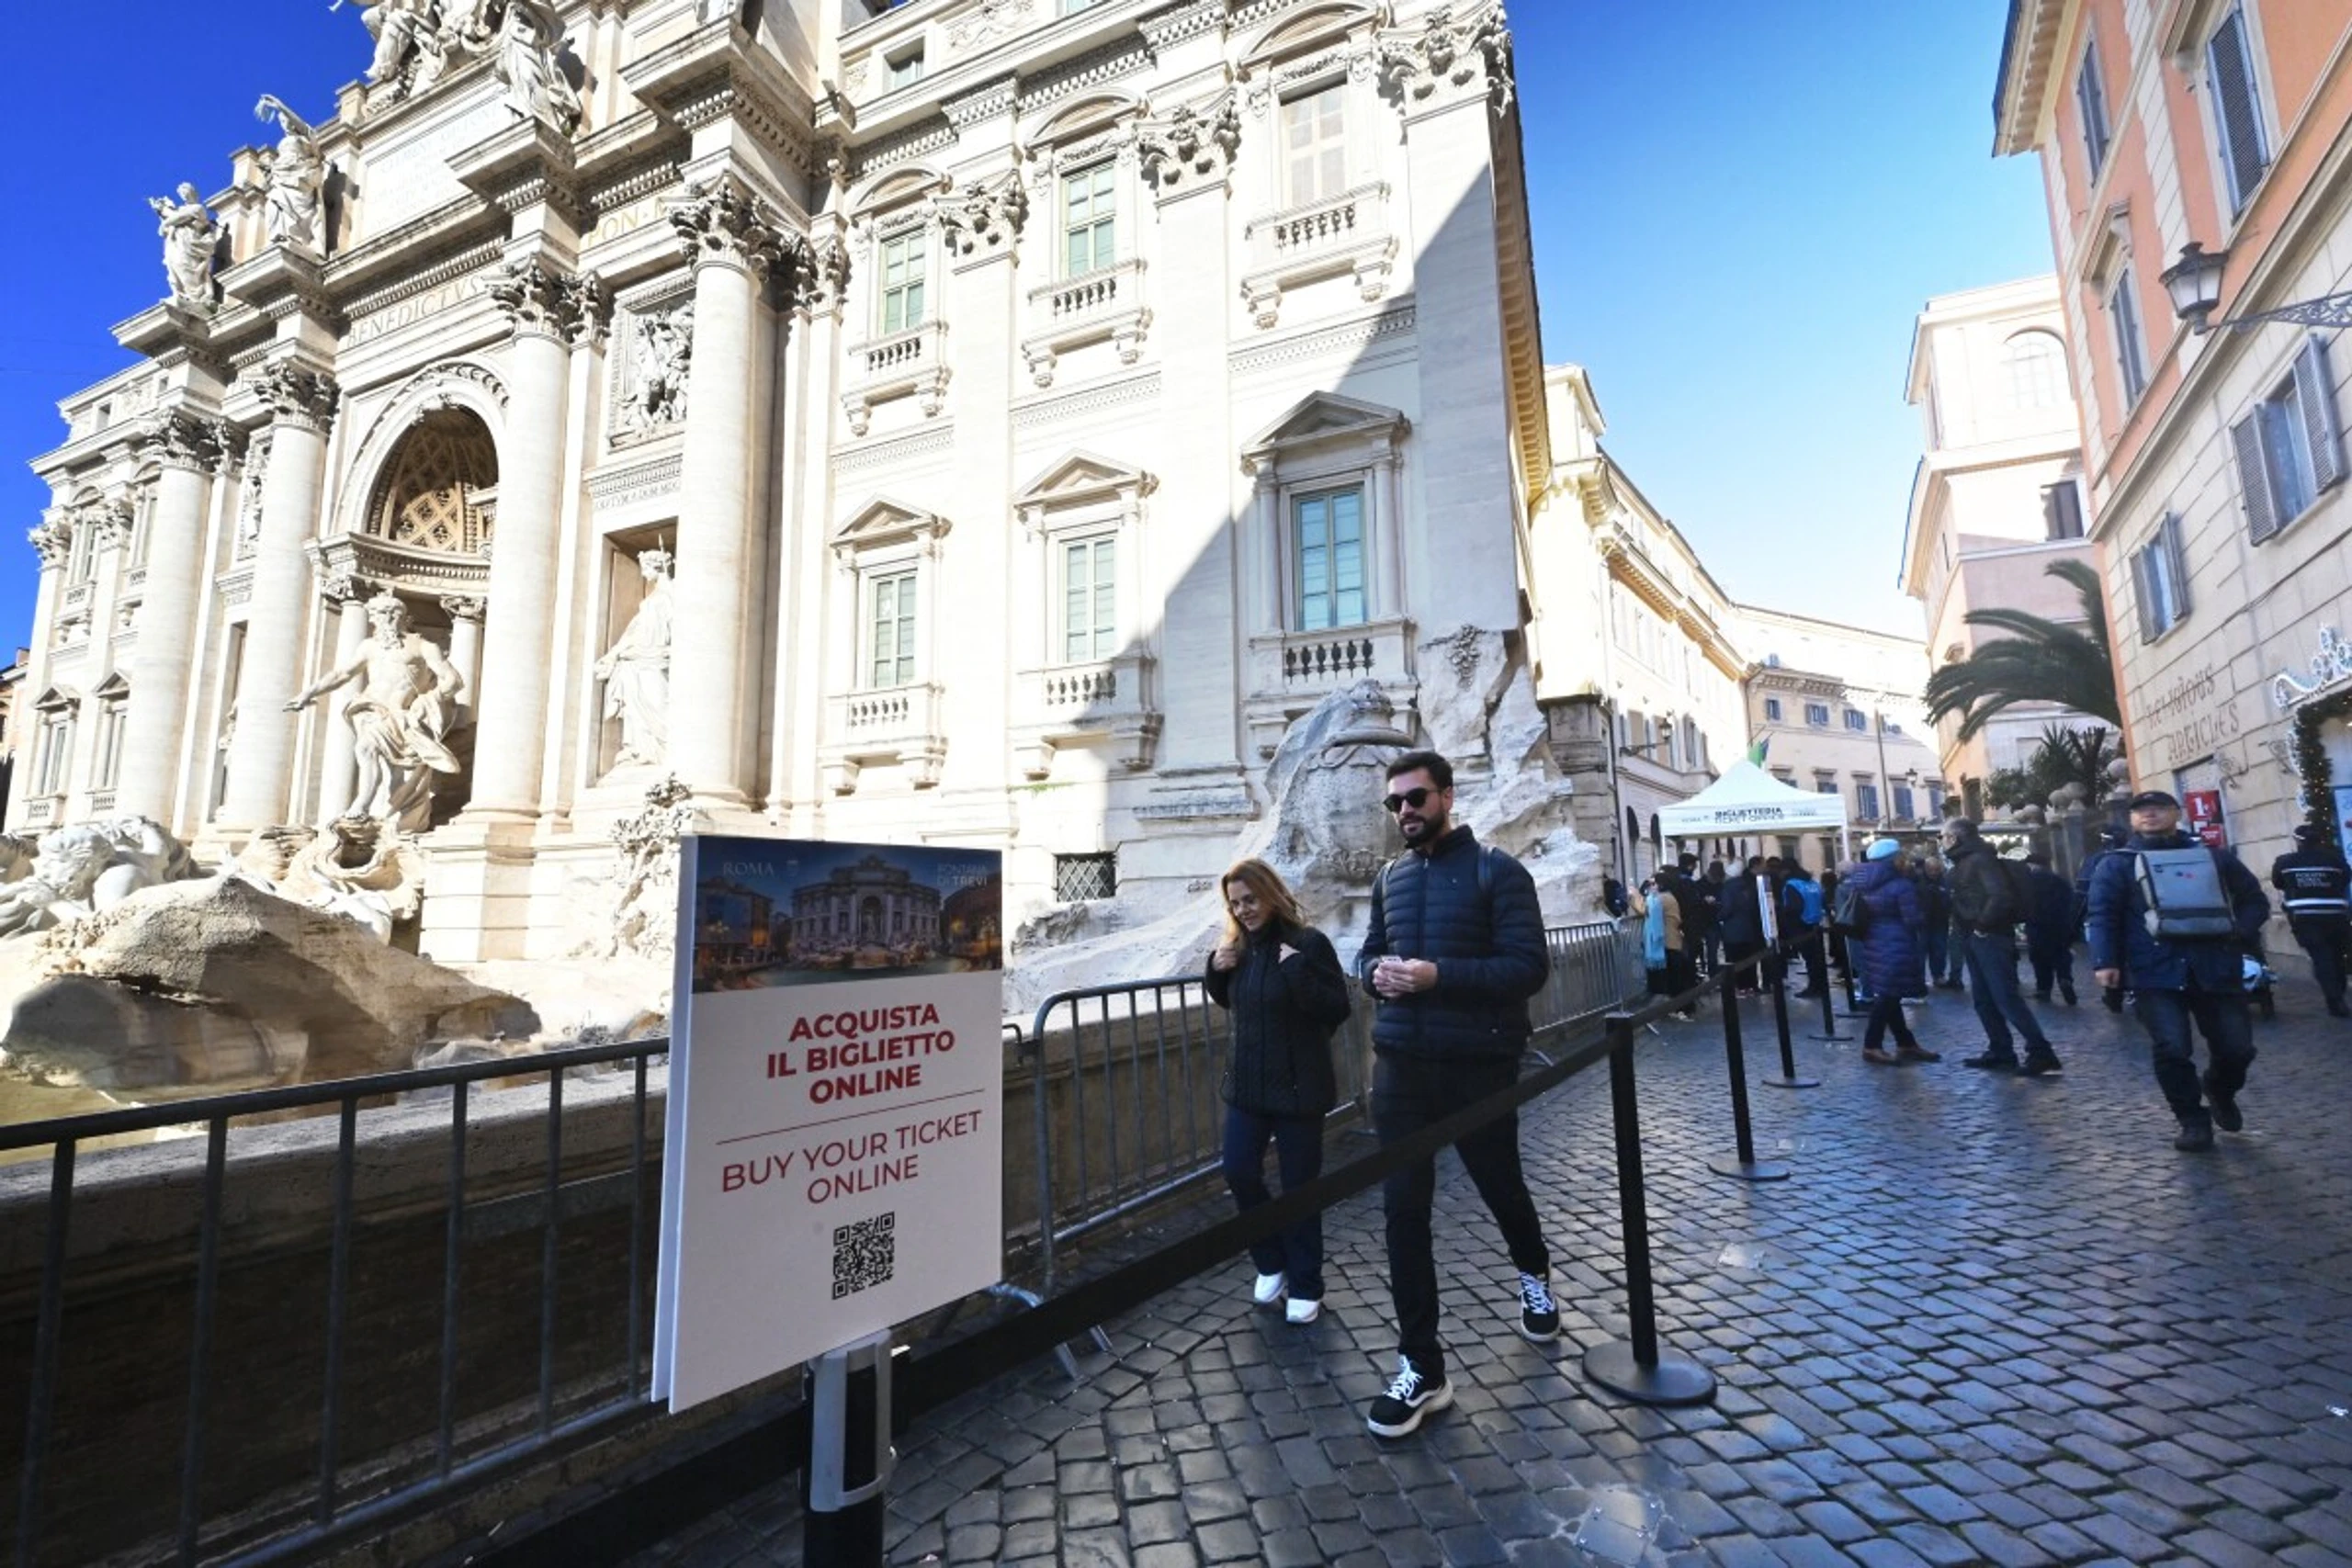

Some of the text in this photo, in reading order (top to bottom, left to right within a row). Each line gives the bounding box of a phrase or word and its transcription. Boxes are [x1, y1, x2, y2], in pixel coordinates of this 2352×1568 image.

[723, 862, 775, 877] ROMA
[954, 875, 988, 887] TREVI
[788, 1003, 940, 1042] ACQUISTA
[766, 1031, 956, 1078] IL BIGLIETTO
[809, 1065, 922, 1104] ONLINE
[721, 1110, 983, 1193] BUY YOUR TICKET
[807, 1154, 919, 1205] ONLINE
